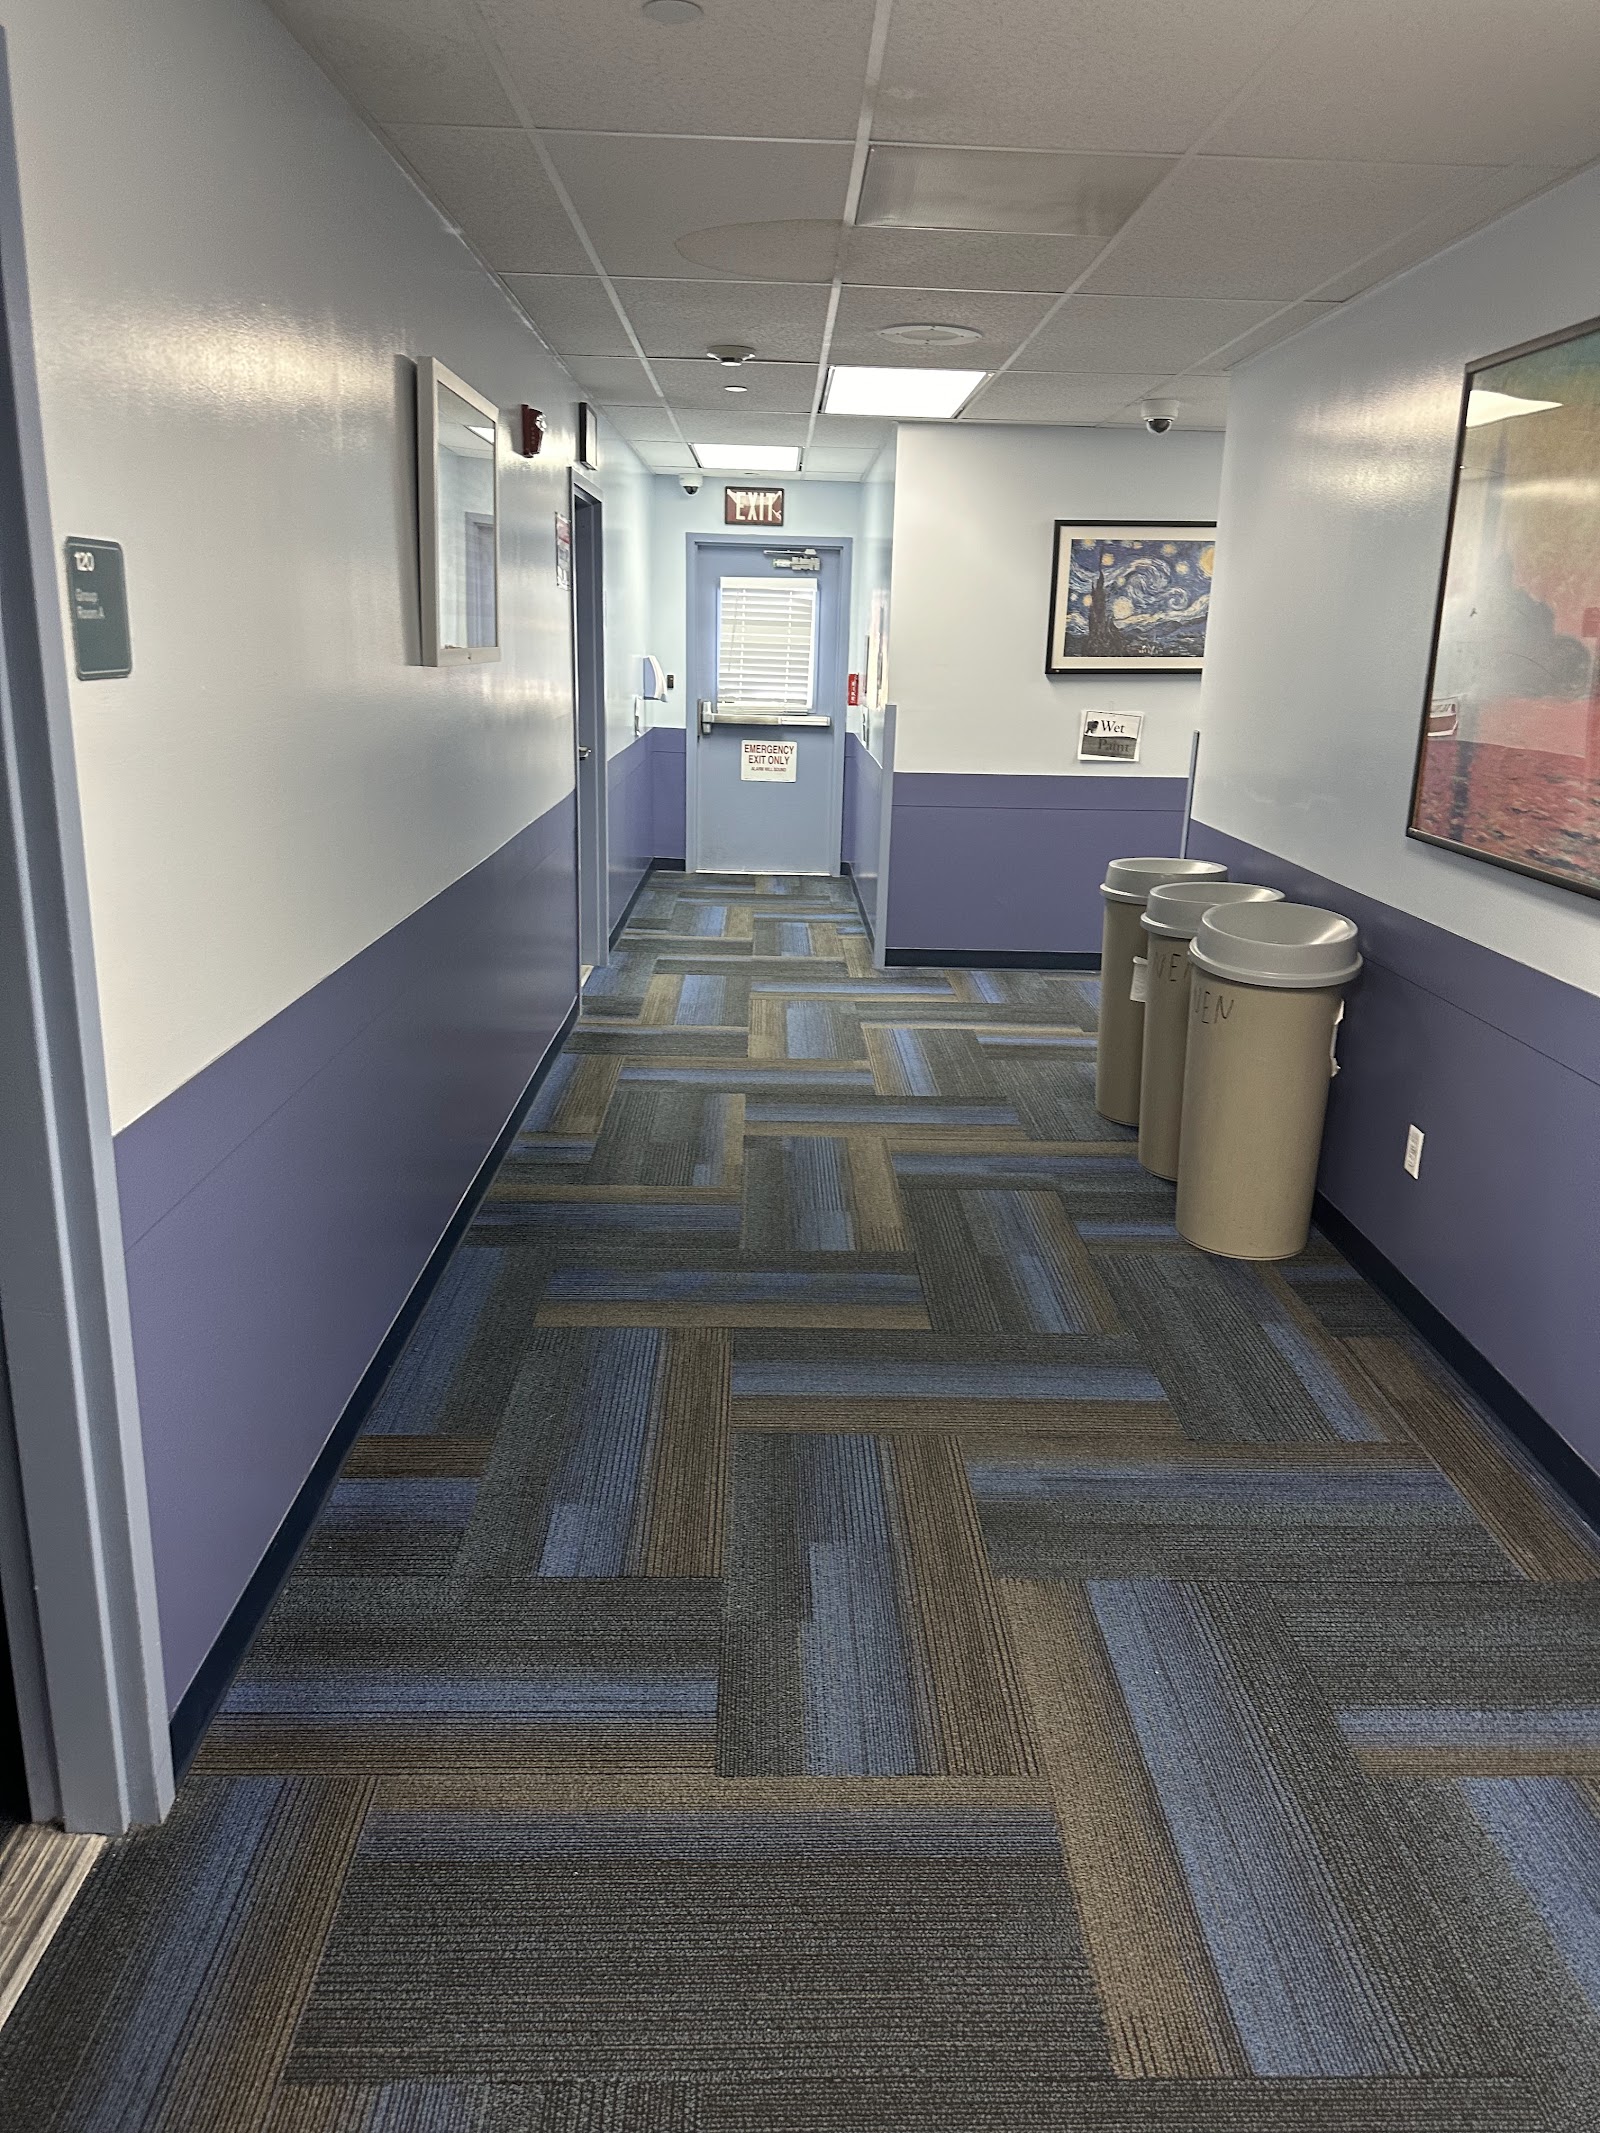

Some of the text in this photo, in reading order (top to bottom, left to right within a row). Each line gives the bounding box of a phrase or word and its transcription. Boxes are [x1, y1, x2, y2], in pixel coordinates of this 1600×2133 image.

[735, 492, 776, 521] EXIT
[74, 551, 95, 572] 120
[1101, 720, 1126, 733] Wet
[744, 744, 795, 755] EMERGENCY
[1098, 738, 1130, 752] Paint
[748, 754, 790, 765] EXIT ONLY
